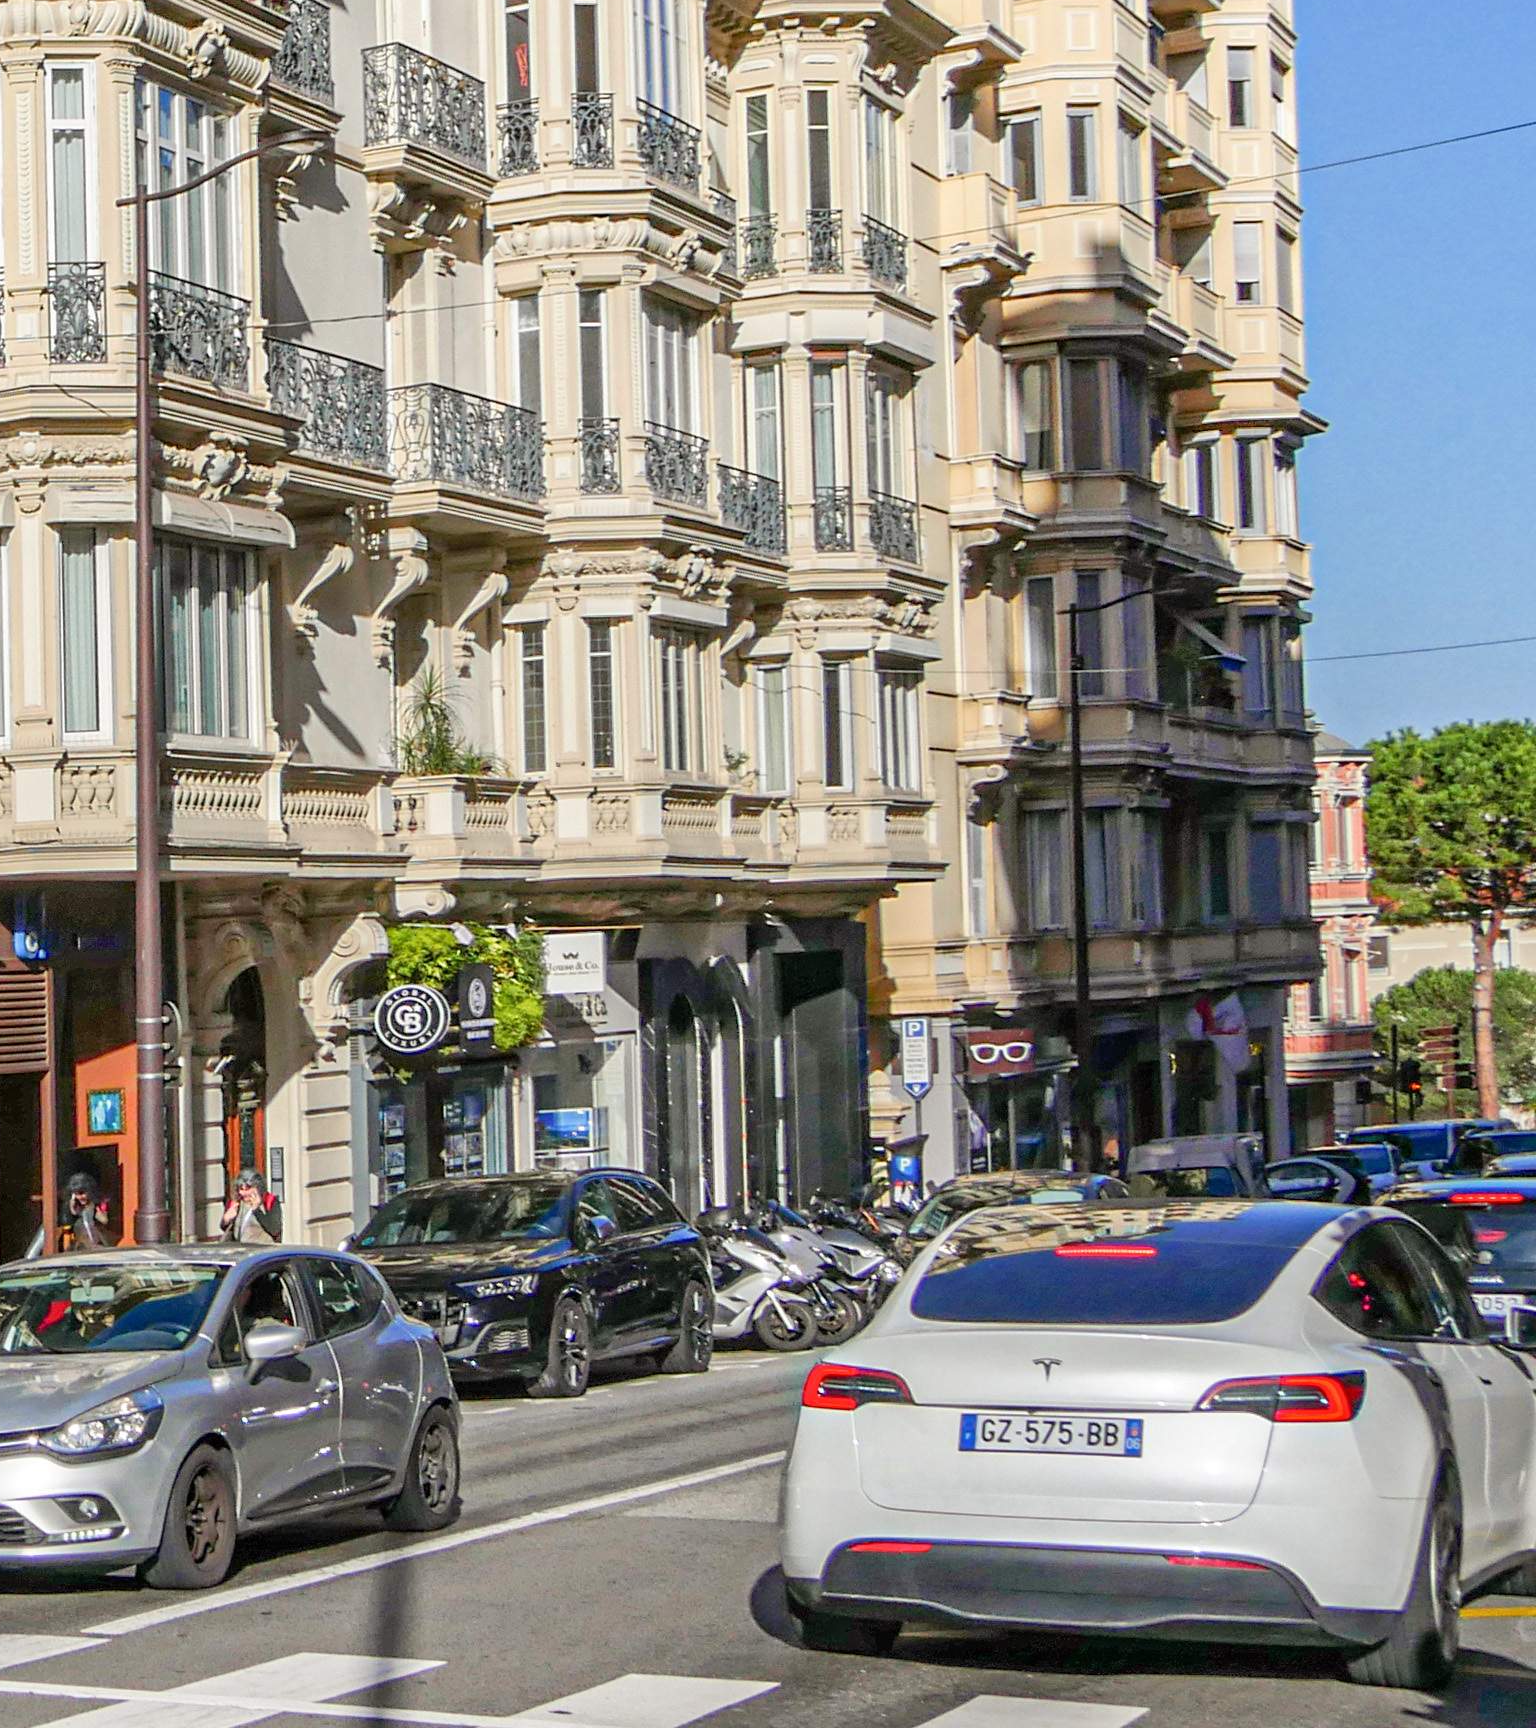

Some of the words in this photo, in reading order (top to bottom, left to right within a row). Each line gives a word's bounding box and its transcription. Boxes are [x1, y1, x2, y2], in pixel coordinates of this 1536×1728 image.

[908, 1022, 921, 1037] P
[899, 1158, 911, 1172] P
[980, 1418, 1119, 1447] GZ-575-BB
